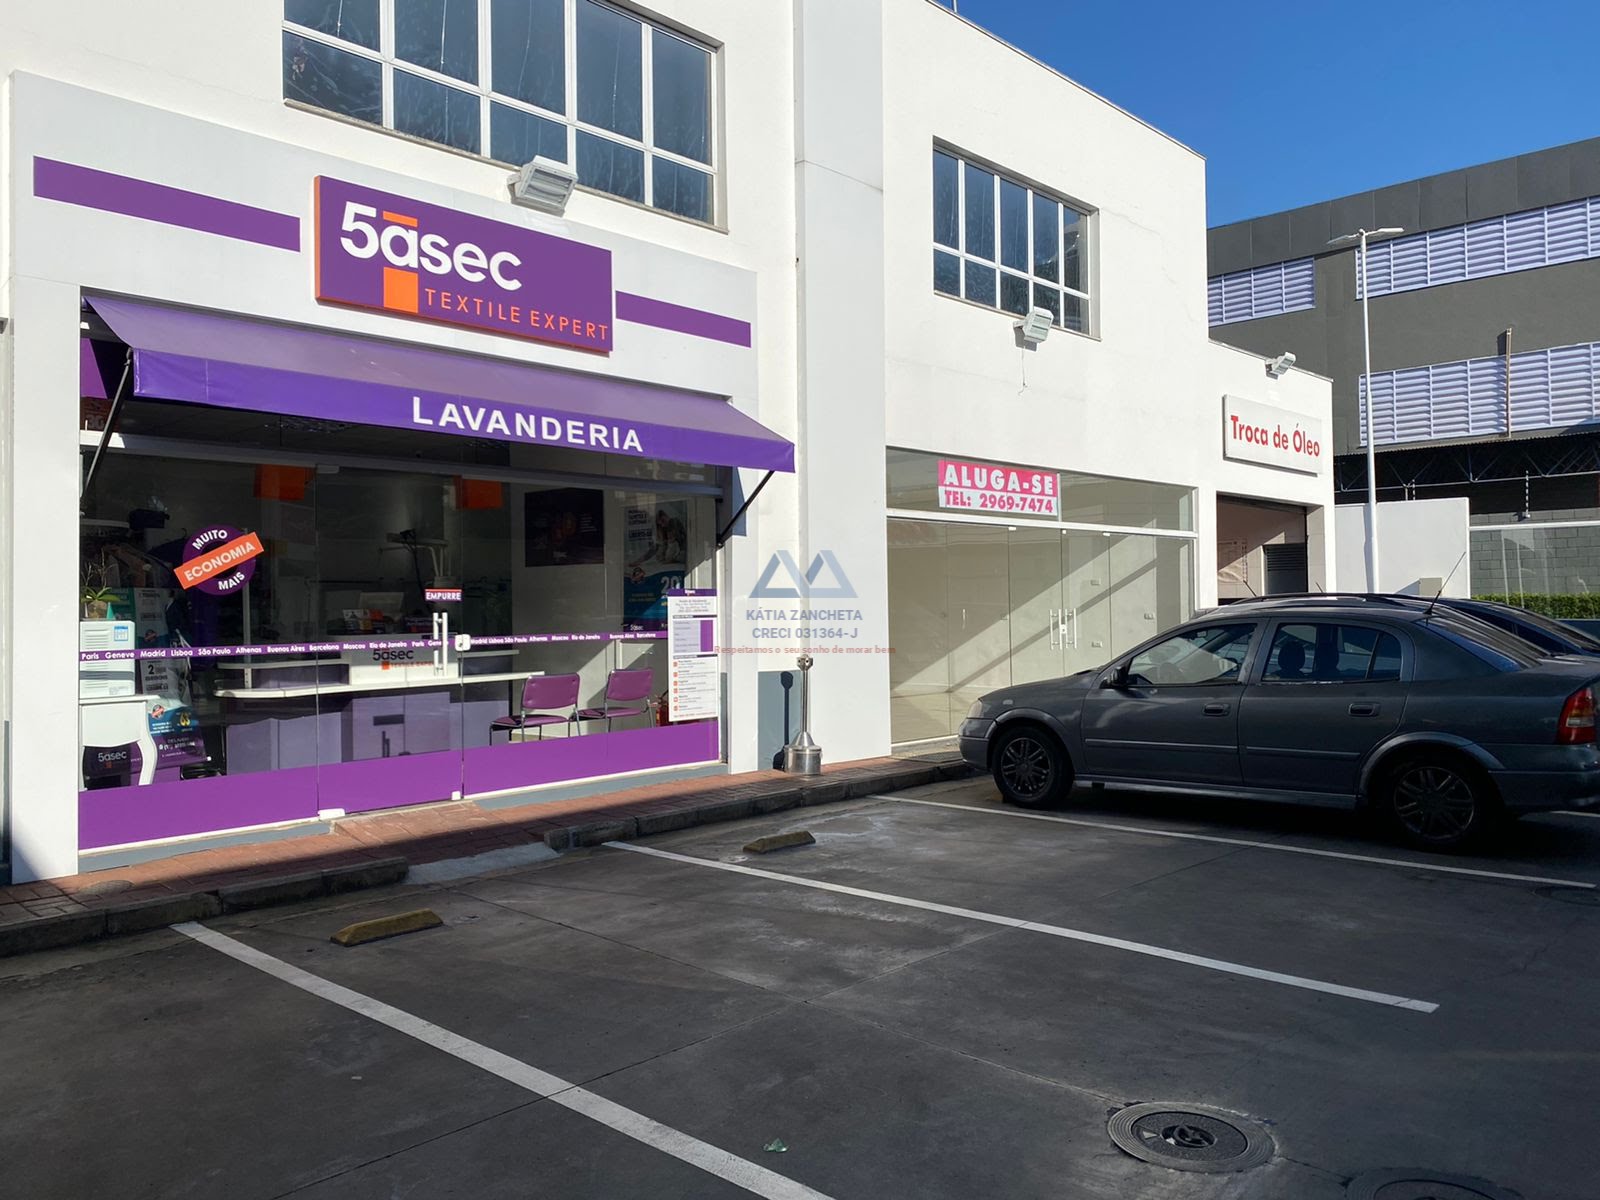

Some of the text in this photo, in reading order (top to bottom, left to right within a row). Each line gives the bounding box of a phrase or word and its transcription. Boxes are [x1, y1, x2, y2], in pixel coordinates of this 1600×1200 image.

[425, 288, 608, 340] TEXTILE EXPERT
[412, 396, 643, 452] LAVANDERIA
[1230, 414, 1320, 457] Troca de Óleo
[943, 464, 1053, 495] ALUGA-SE
[944, 490, 1053, 513] TEL: 2969-7474
[192, 529, 228, 550] MUITO
[184, 542, 256, 582] ECONOMIA
[218, 571, 245, 591] MAIS
[425, 591, 461, 601] EMPURRE
[81, 652, 99, 660] Paris
[140, 650, 166, 658] Madrid
[171, 649, 193, 657] Lisboa
[198, 648, 211, 656] São
[236, 646, 262, 654] Athenas
[267, 645, 289, 653] Buenos
[309, 643, 340, 651] Barcelona
